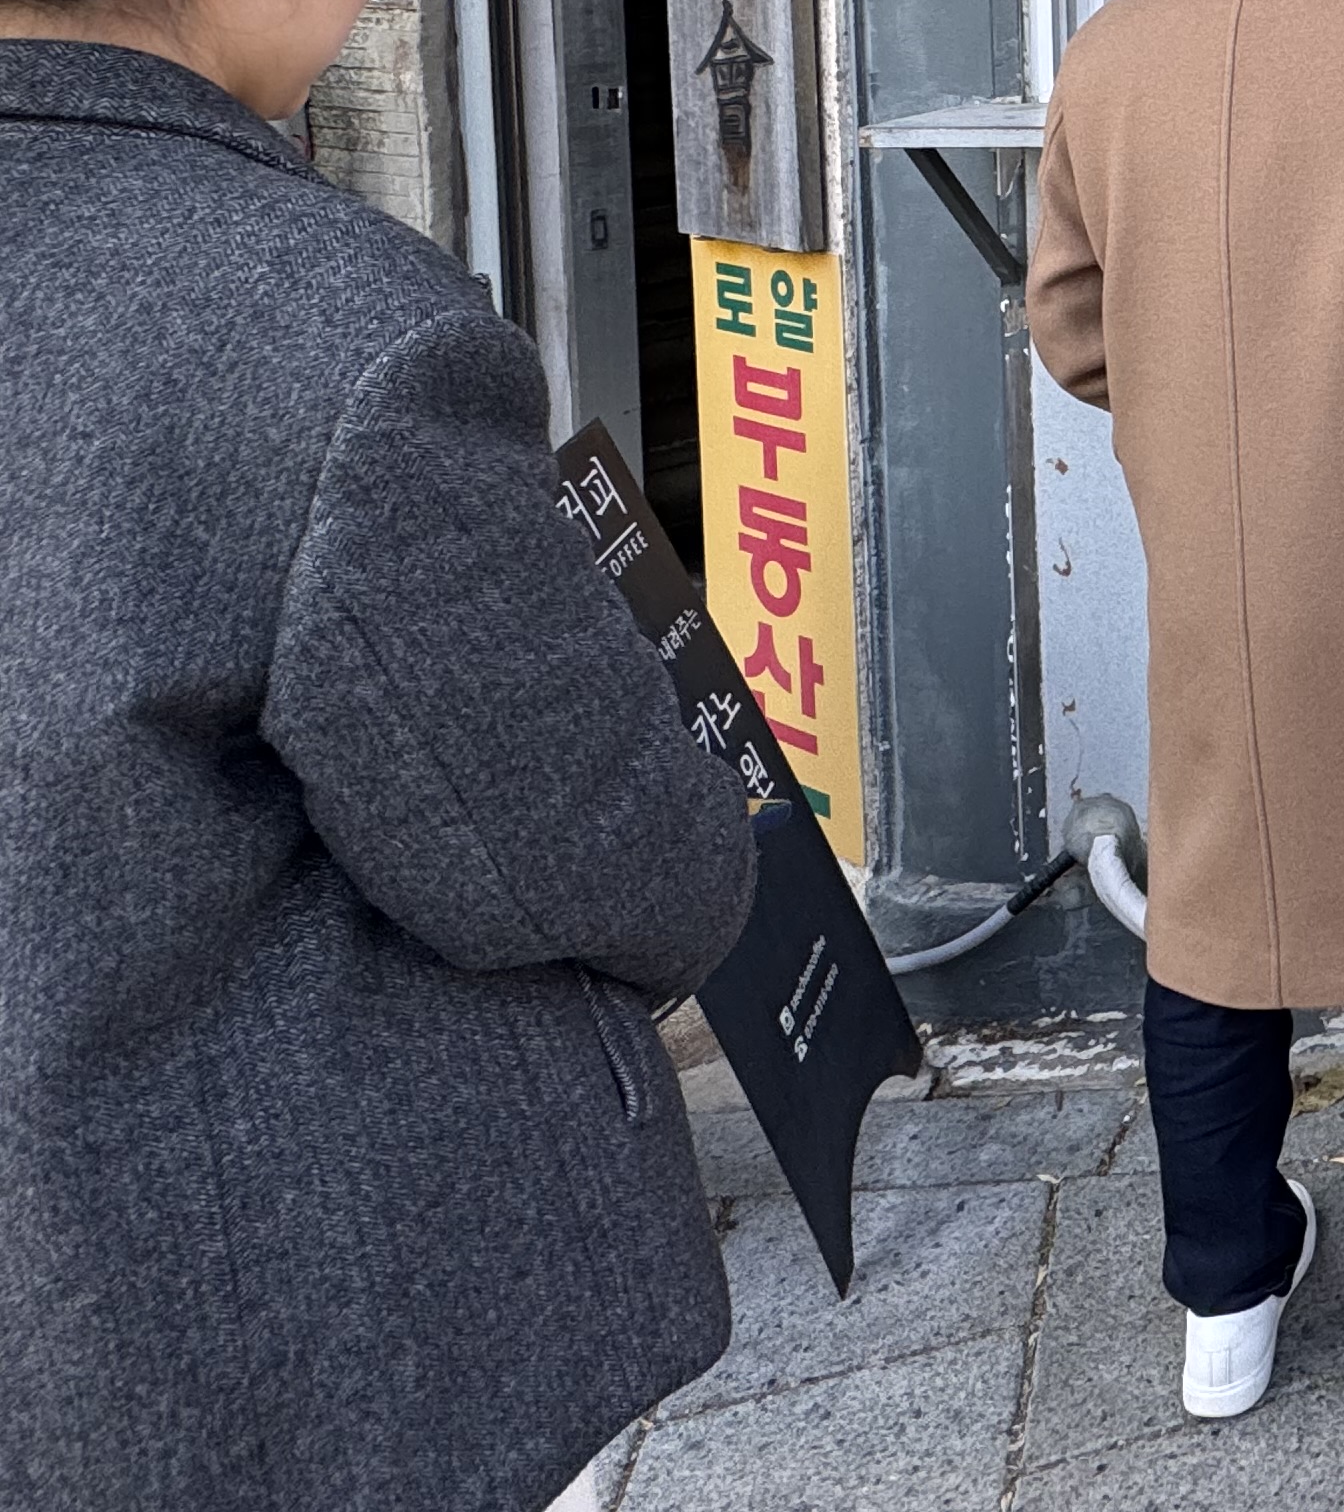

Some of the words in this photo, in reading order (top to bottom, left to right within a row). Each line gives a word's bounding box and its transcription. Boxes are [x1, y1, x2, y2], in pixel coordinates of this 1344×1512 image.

[715, 261, 819, 354] 로얄
[600, 530, 649, 583] OFFEE
[732, 354, 825, 756] 부동산
